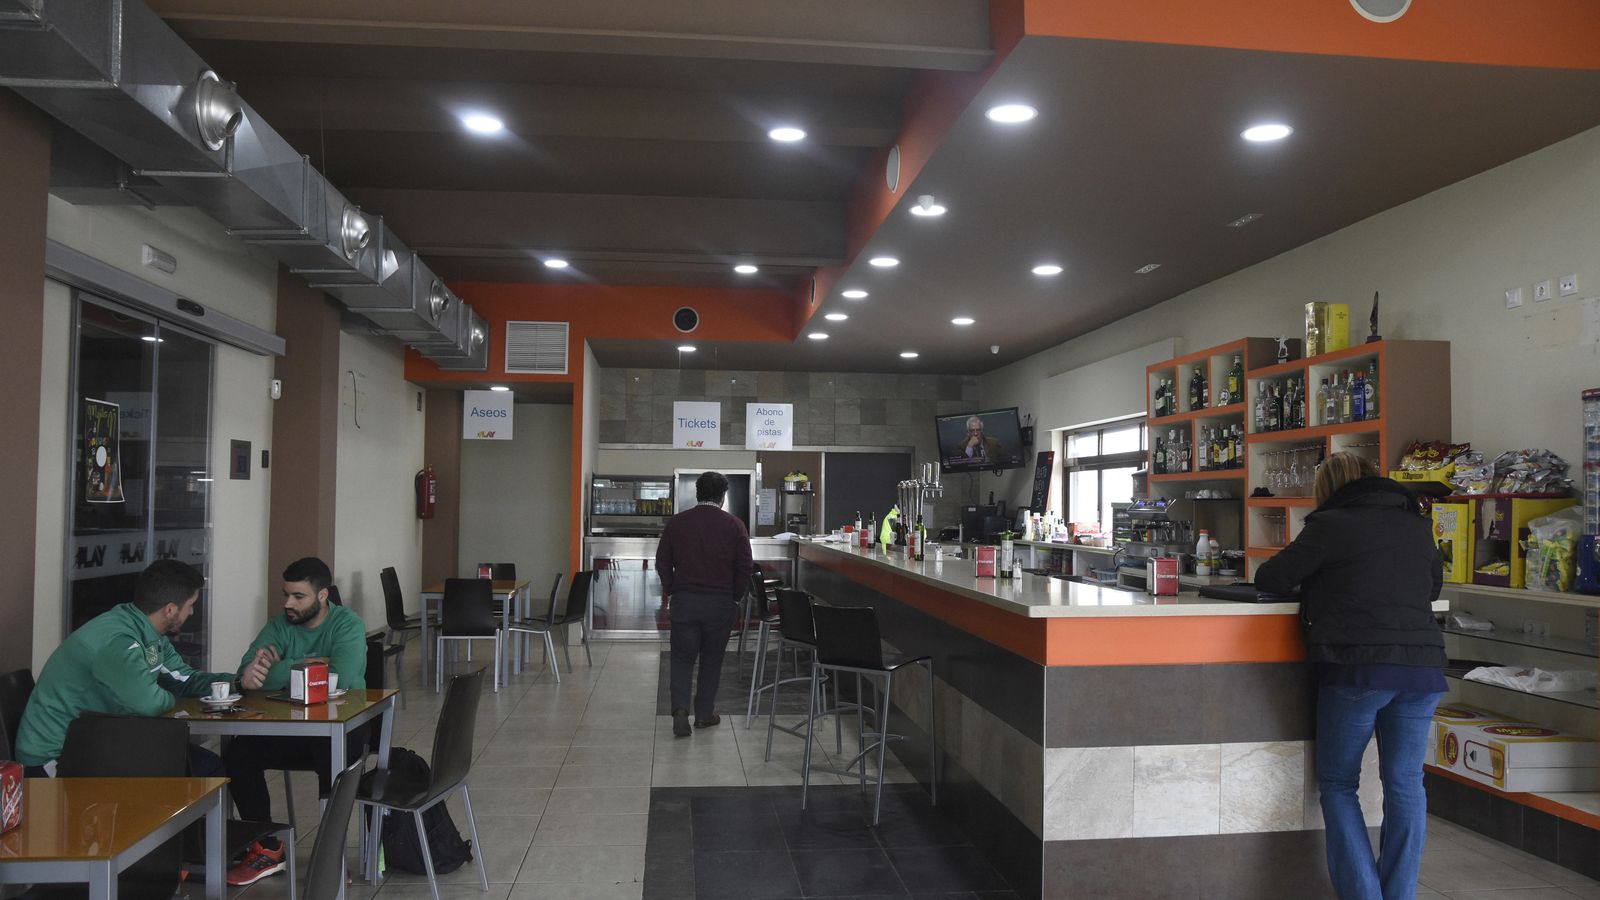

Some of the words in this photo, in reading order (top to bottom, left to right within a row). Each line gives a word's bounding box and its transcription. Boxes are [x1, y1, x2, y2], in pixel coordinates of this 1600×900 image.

[470, 407, 507, 418] Aseos
[756, 407, 784, 416] Abono
[678, 417, 717, 429] Tickets
[757, 428, 782, 437] pistas
